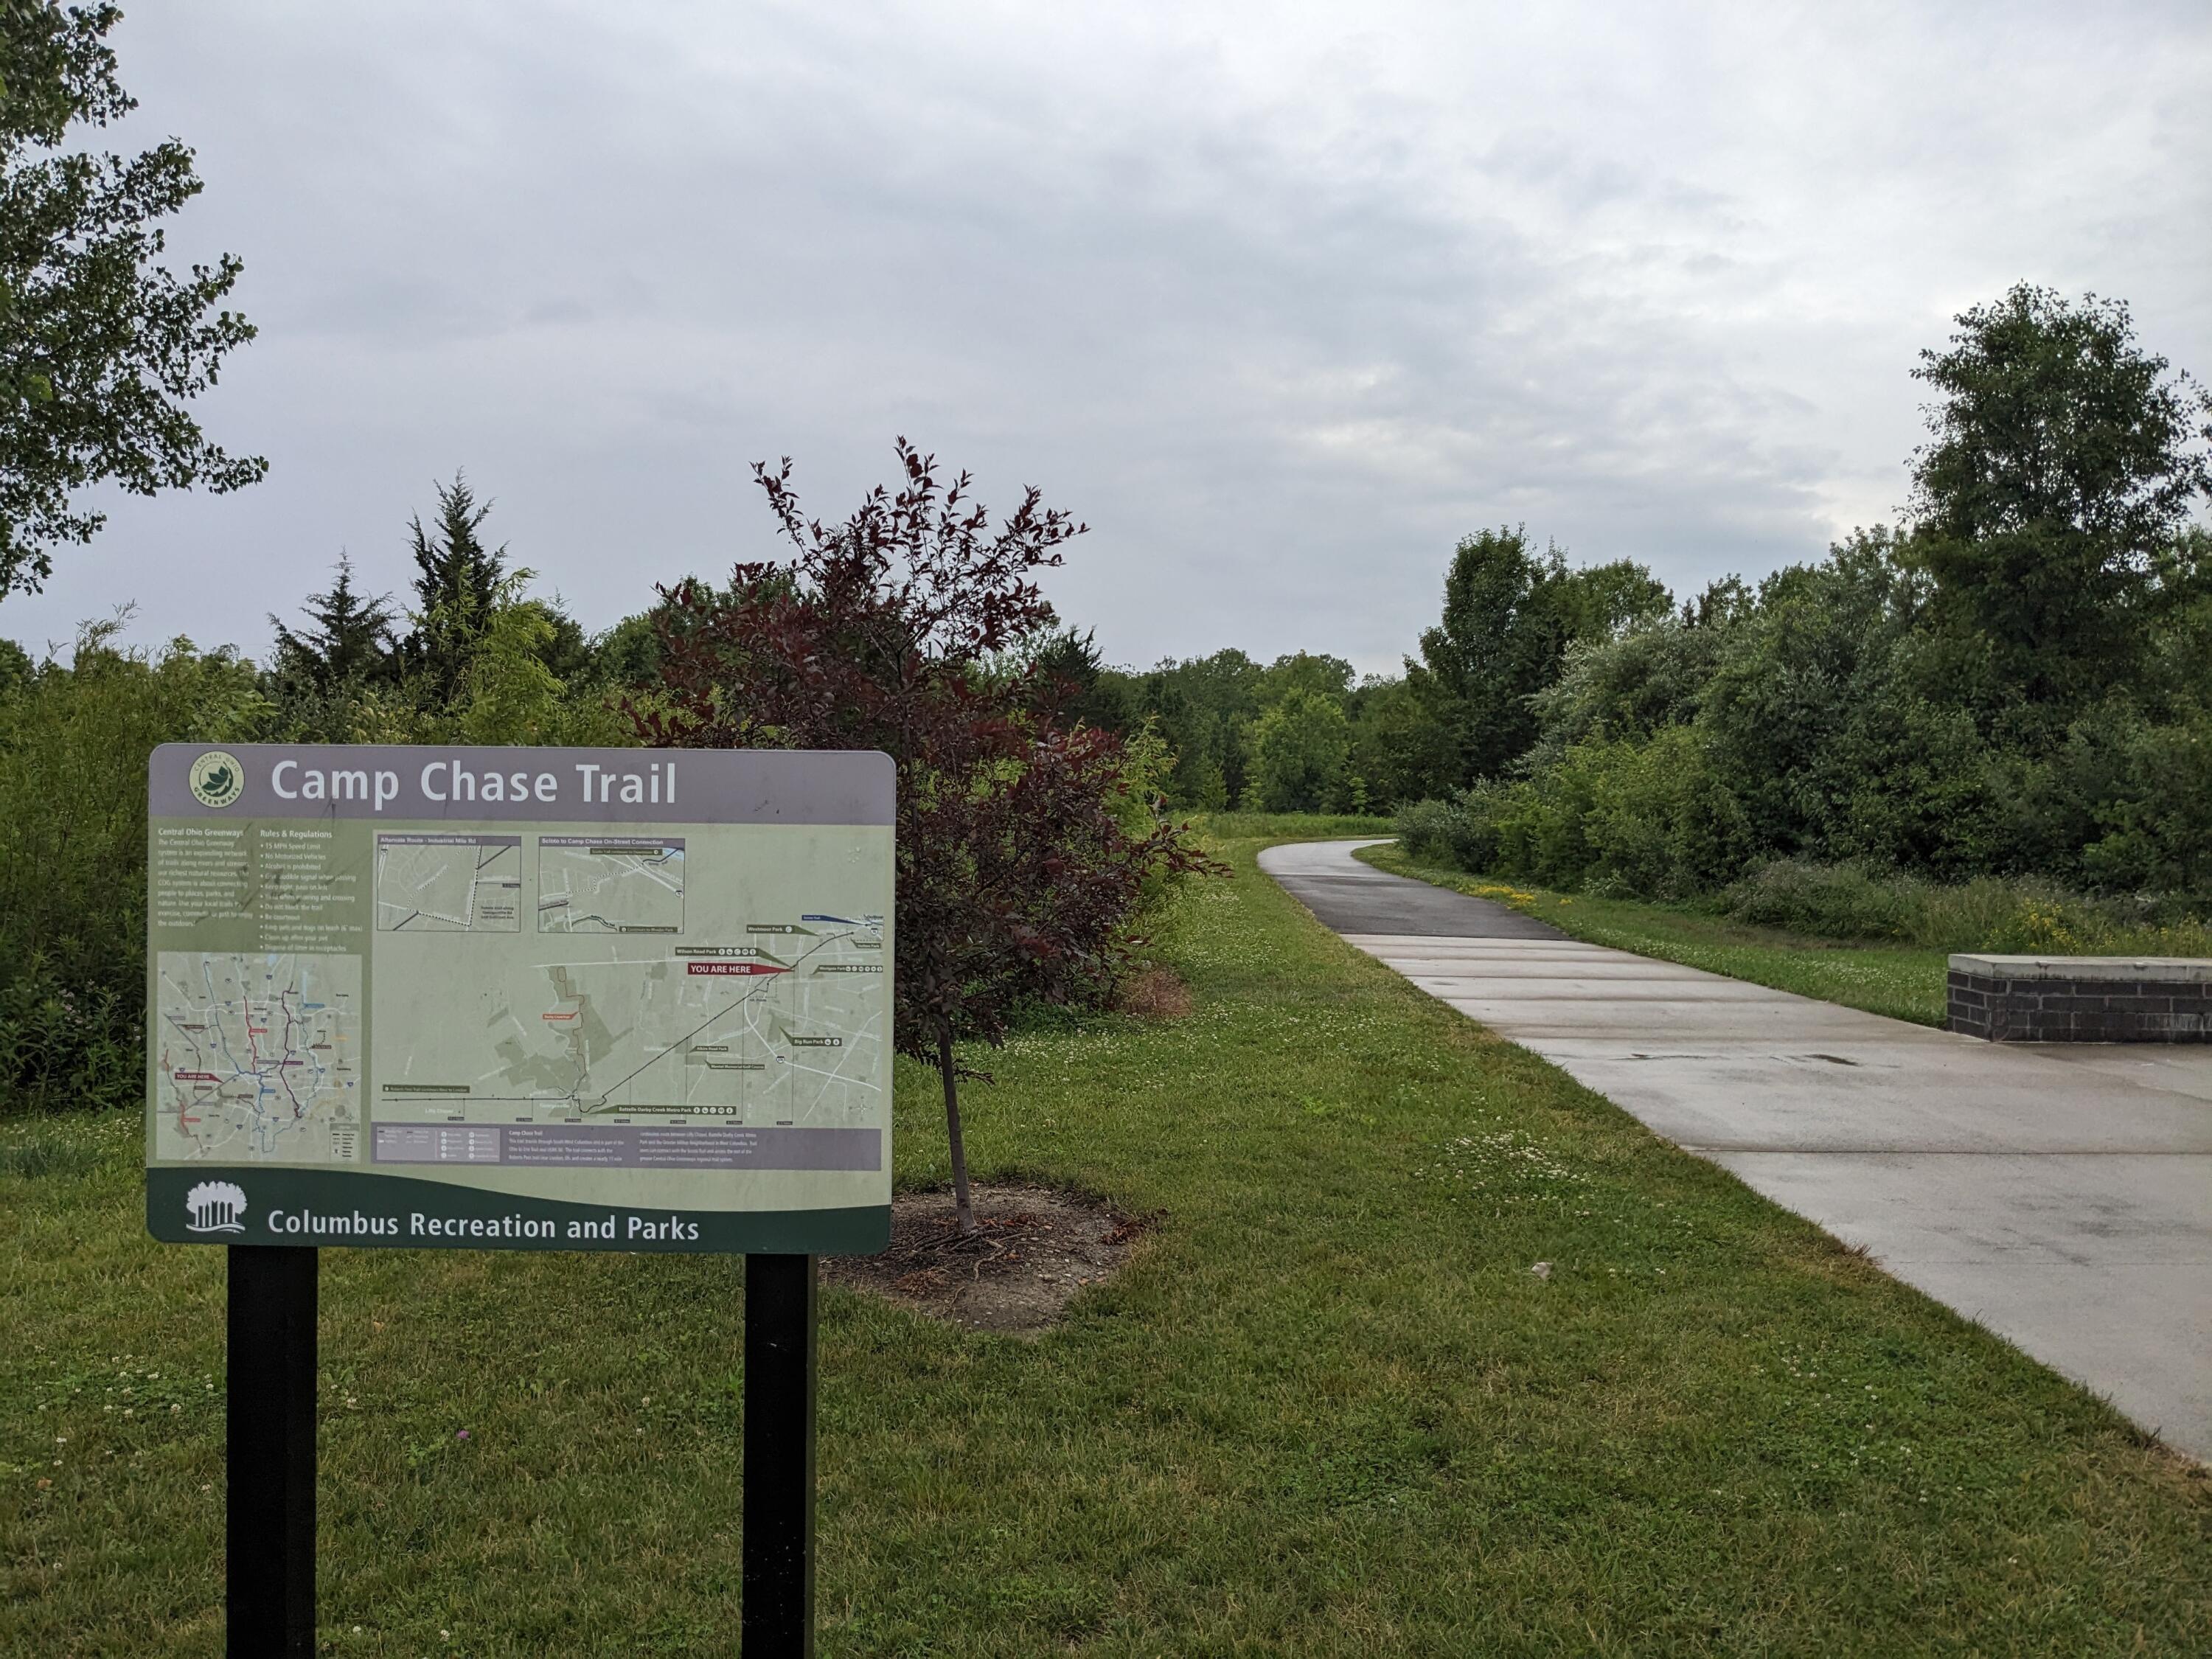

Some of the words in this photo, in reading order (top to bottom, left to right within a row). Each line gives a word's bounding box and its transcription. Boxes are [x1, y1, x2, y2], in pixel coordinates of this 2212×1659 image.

[195, 754, 221, 771] CENTRAL
[226, 757, 240, 773] OHIO
[272, 760, 399, 811] Camp
[421, 760, 557, 802] Chase
[575, 762, 675, 803] Trail
[194, 787, 240, 805] GREENWAYS
[204, 829, 243, 838] Greenways
[260, 830, 280, 838] Rules
[289, 830, 333, 840] Regulations
[289, 844, 306, 852] Speed
[691, 965, 709, 973] YOU
[710, 965, 728, 973] ARE
[268, 1209, 399, 1235] Columbus
[411, 1213, 555, 1238] Recreation
[567, 1215, 616, 1239] and
[628, 1216, 699, 1240] Parks
